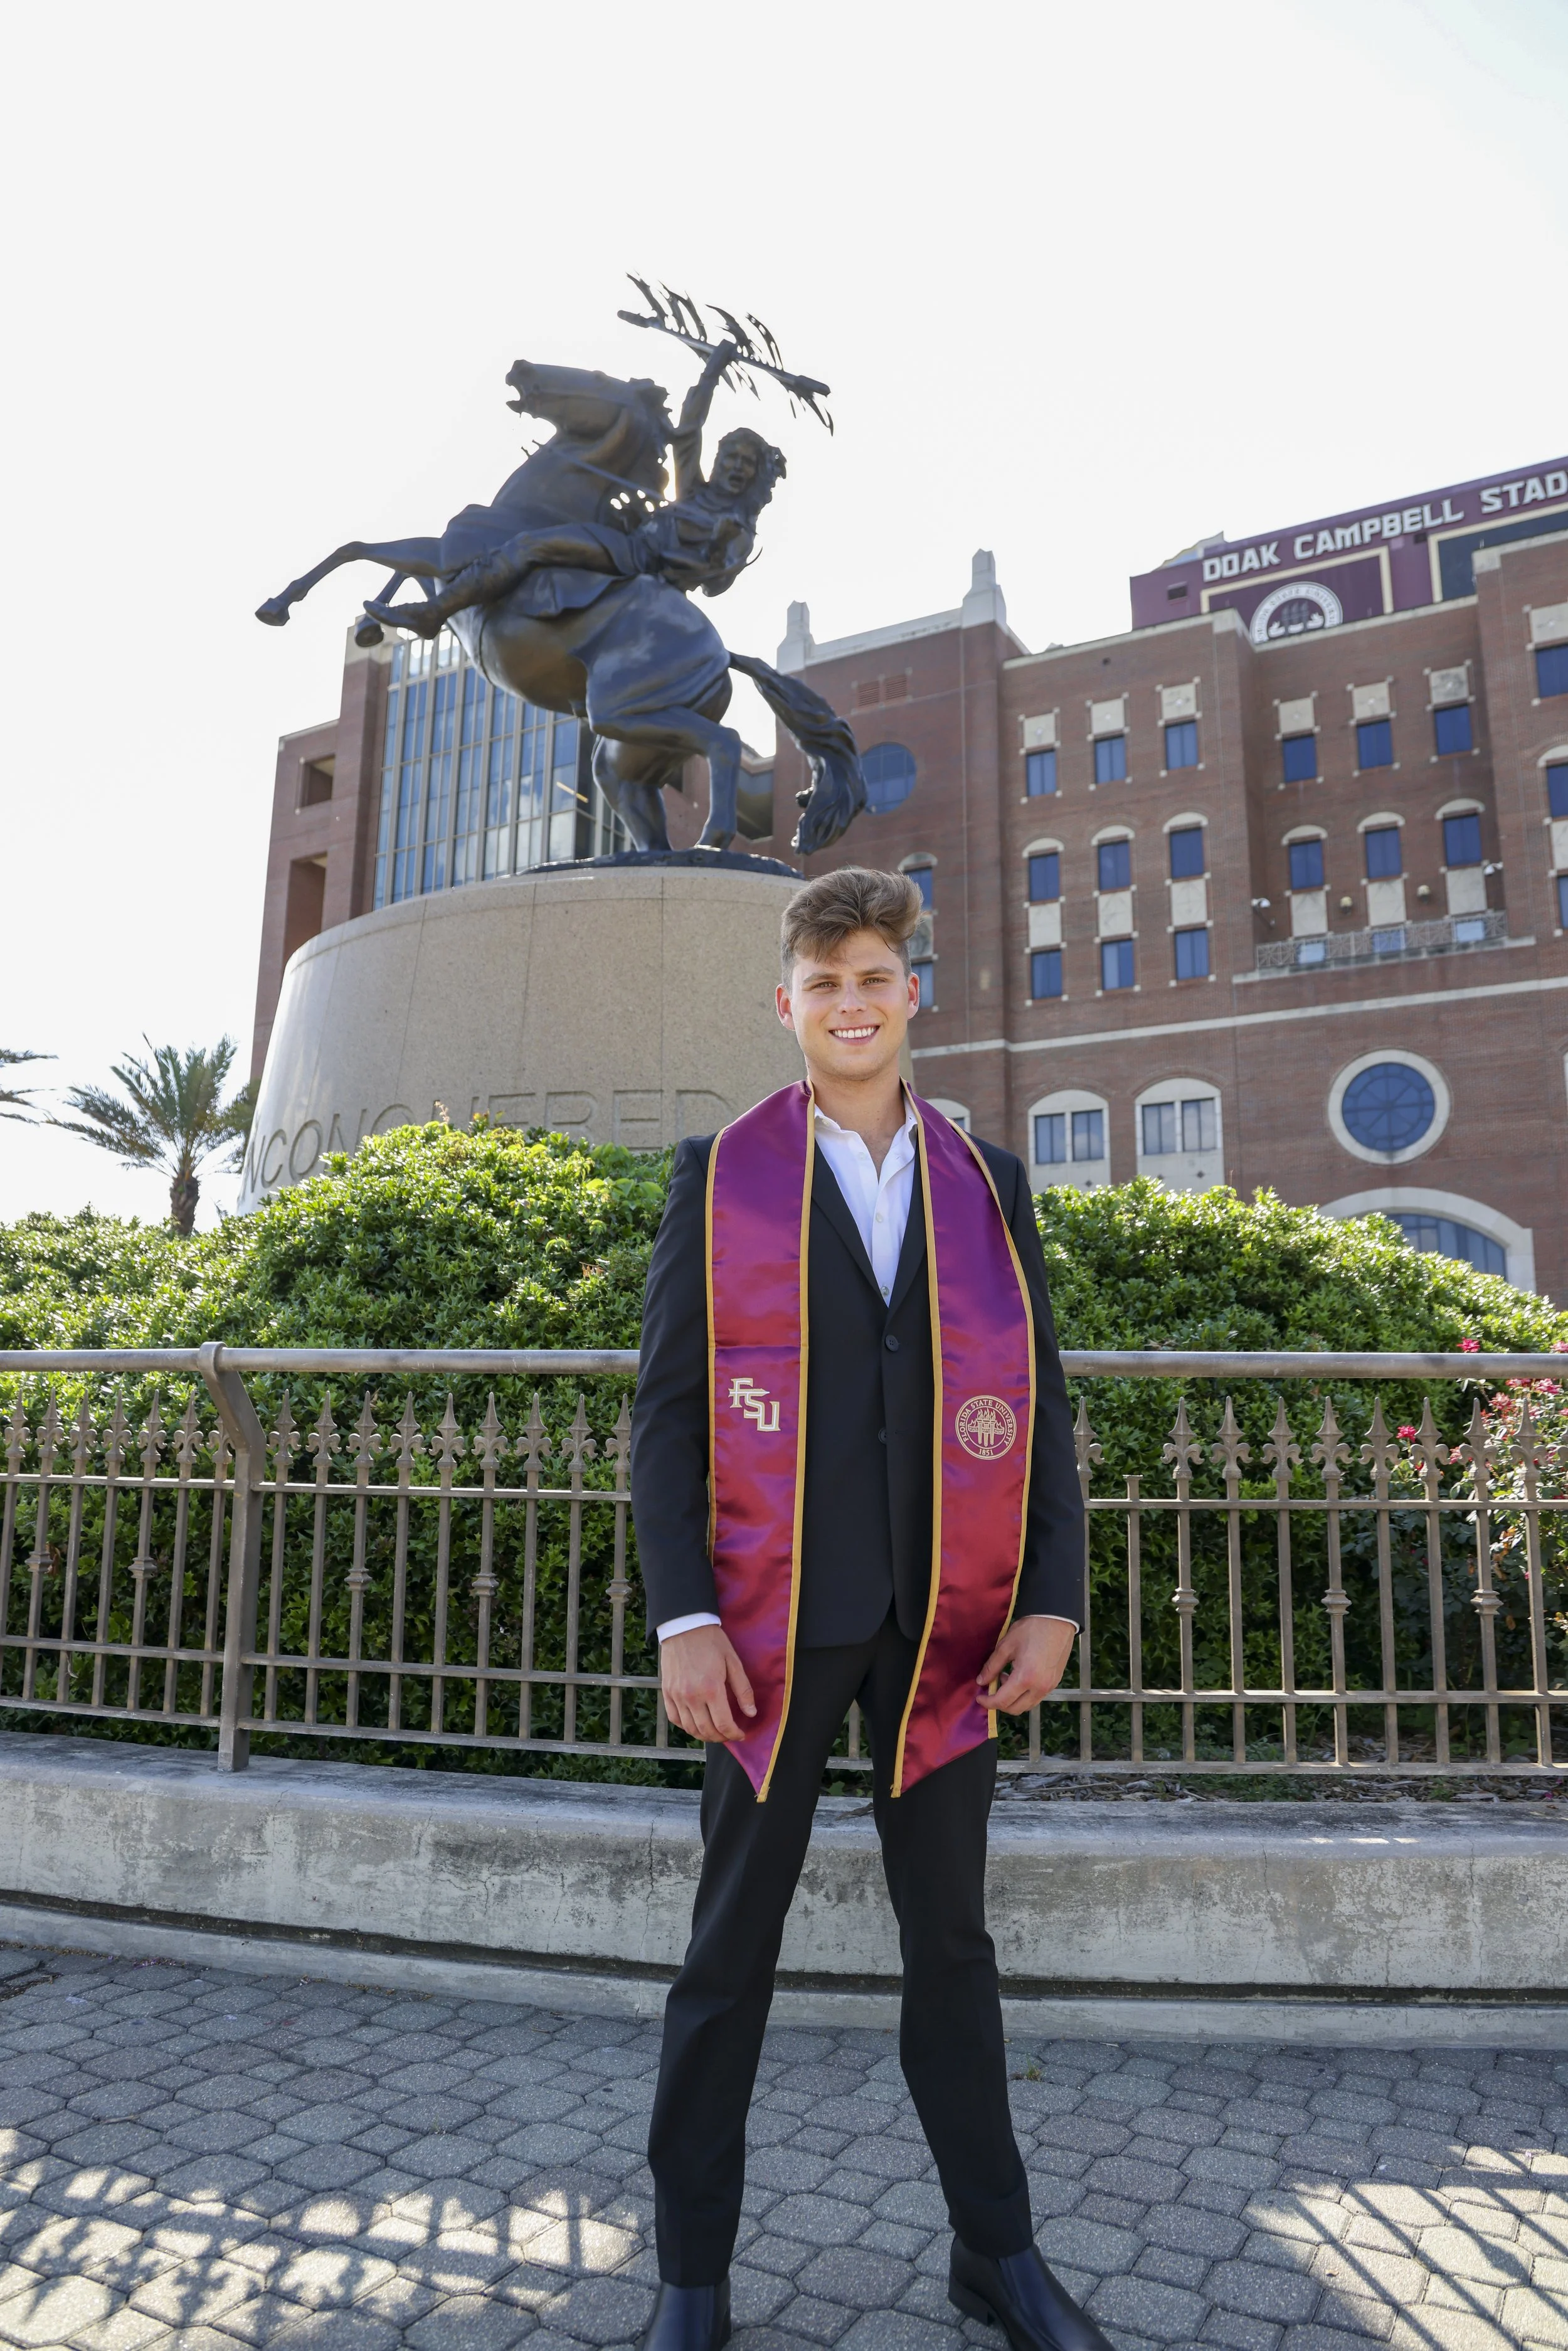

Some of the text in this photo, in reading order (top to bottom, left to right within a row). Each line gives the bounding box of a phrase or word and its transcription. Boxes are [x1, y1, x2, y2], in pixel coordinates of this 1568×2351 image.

[1202, 469, 1568, 583] DOAK CAMPBELL STAD
[728, 1377, 781, 1431] FSU
[959, 1399, 1013, 1446] FLORIDA STATE UNIVERSITY
